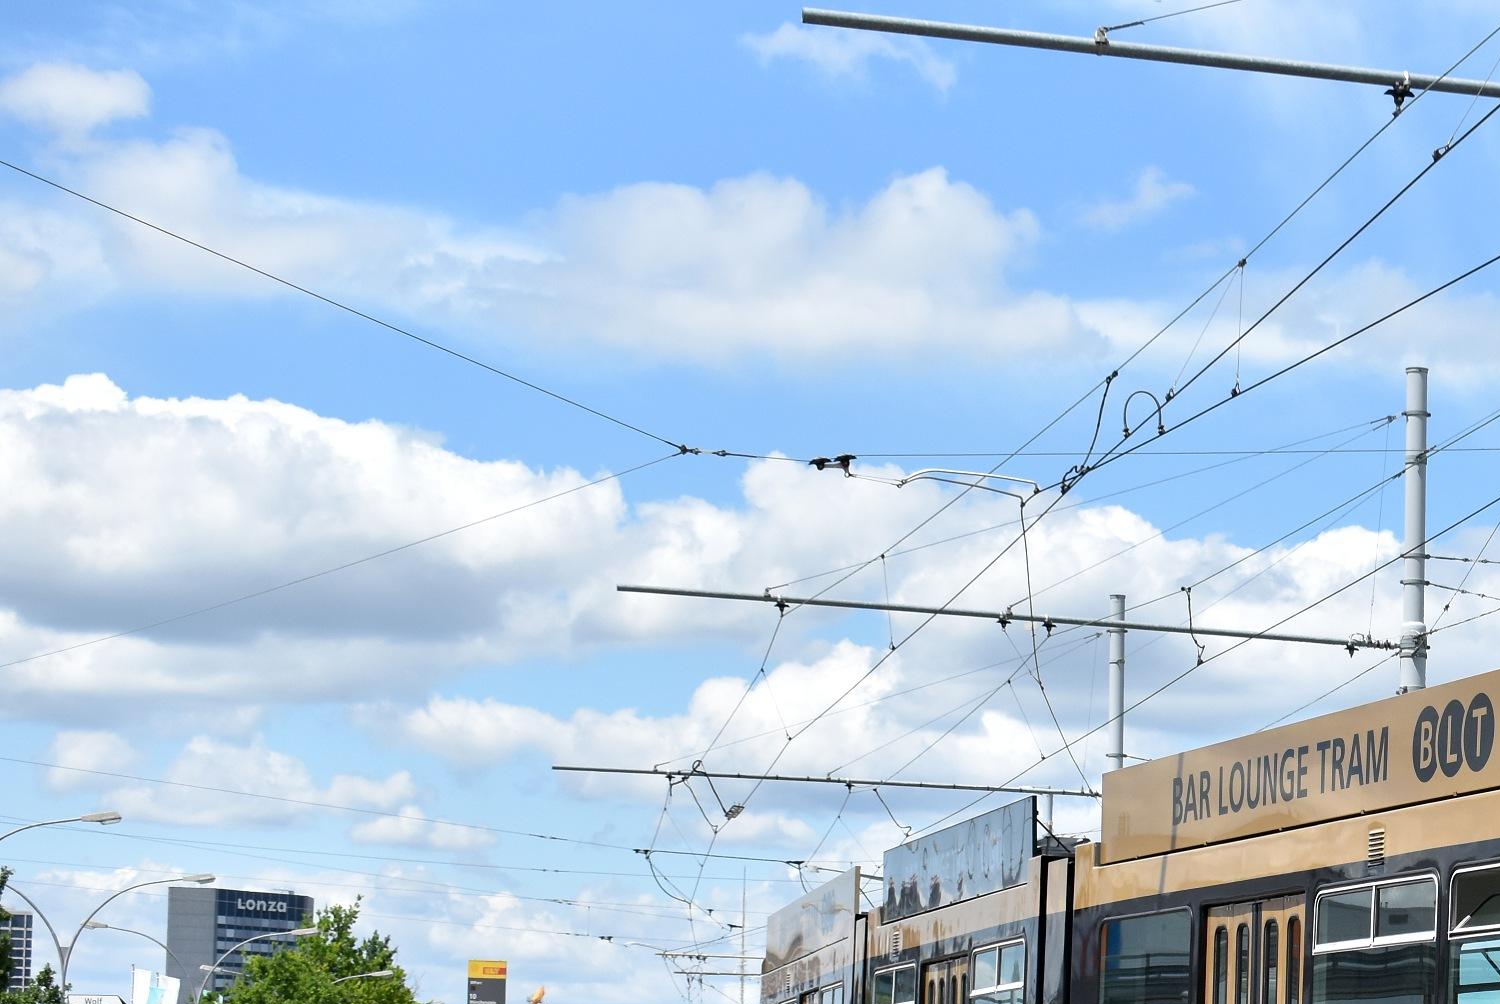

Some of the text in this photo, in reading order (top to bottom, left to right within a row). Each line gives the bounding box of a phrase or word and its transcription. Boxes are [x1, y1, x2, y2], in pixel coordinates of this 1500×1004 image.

[1172, 726, 1389, 826] BAR LOUNGE TRAM
[1416, 700, 1491, 776] BLT
[237, 898, 287, 912] Lonza
